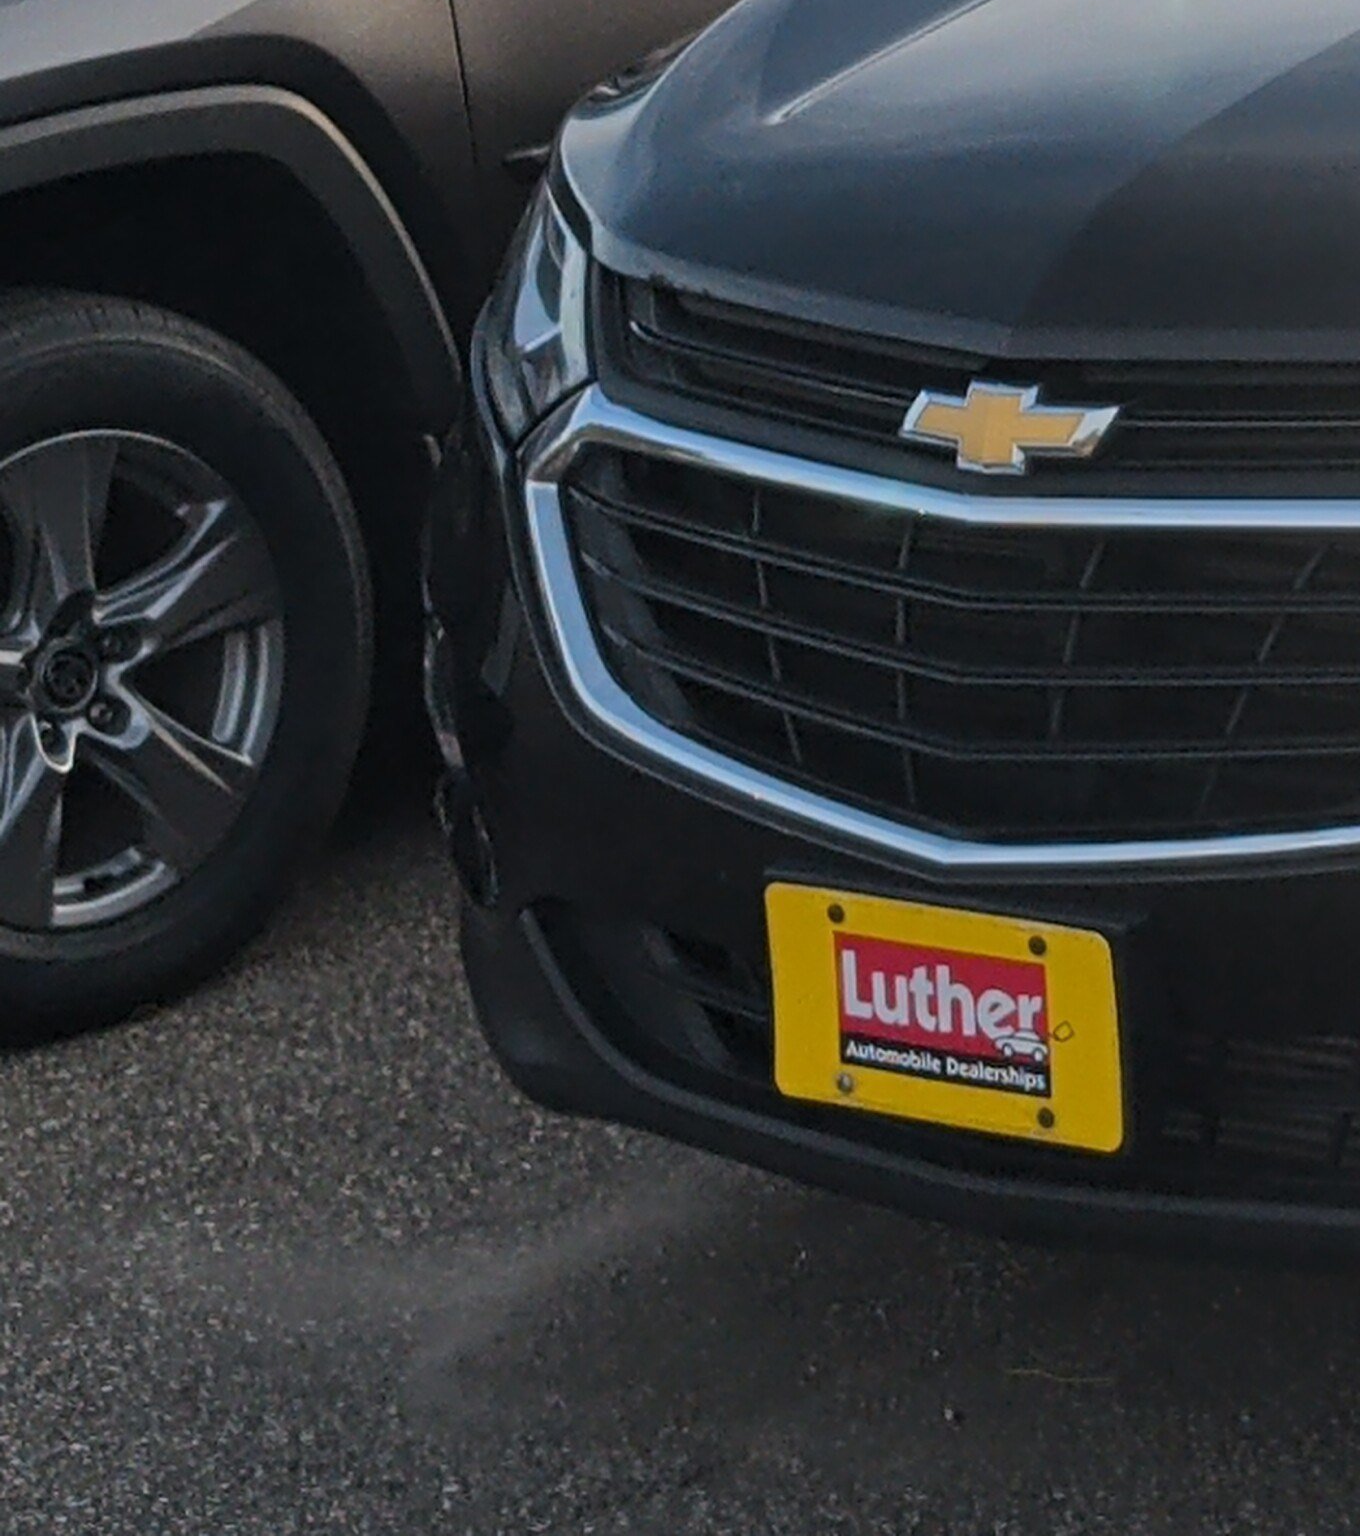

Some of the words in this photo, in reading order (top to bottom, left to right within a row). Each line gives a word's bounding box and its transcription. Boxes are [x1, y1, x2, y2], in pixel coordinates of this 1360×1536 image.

[840, 949, 1043, 1038] Luther
[844, 1040, 942, 1076] Automobile
[946, 1055, 1047, 1092] Dealerships
